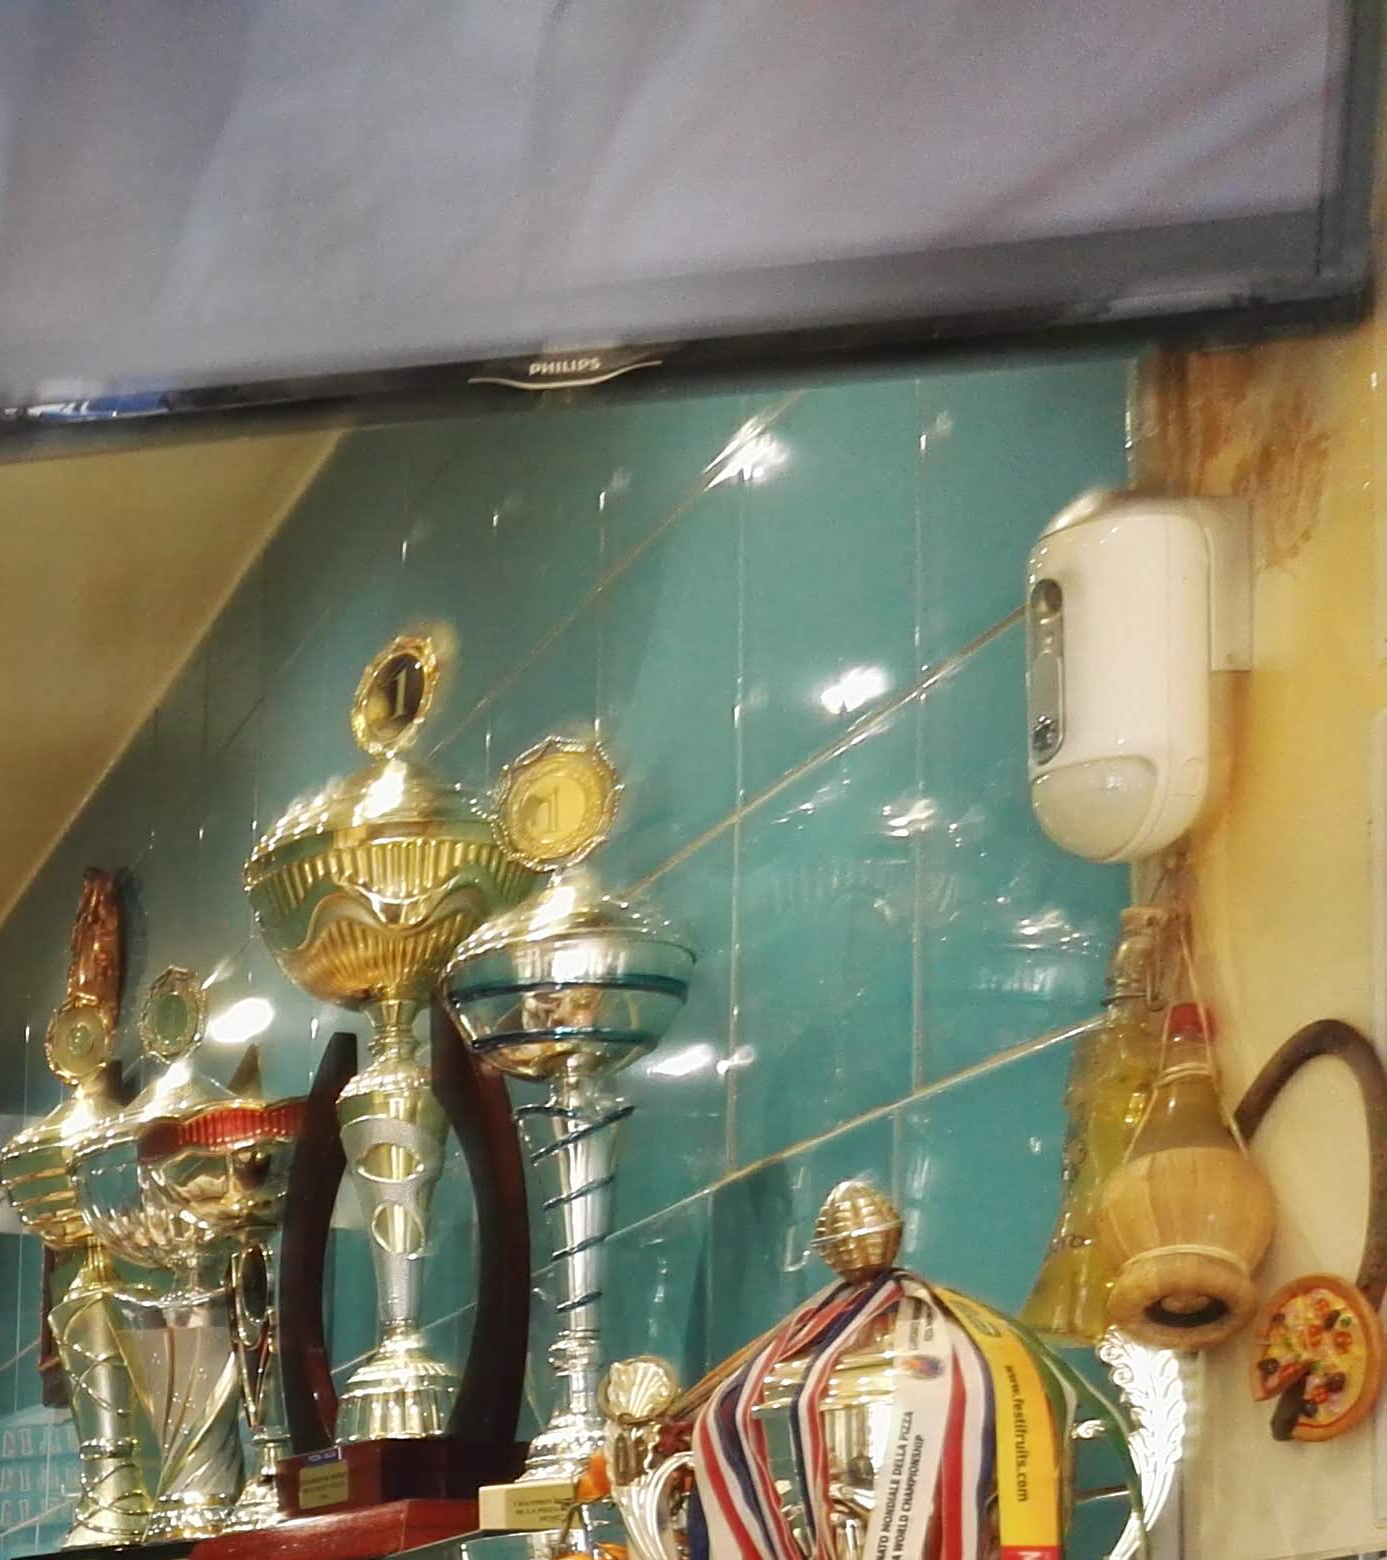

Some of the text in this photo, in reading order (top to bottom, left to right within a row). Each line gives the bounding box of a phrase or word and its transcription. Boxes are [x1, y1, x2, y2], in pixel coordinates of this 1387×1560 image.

[529, 357, 601, 376] PHILIPS
[881, 1484, 899, 1533] MONDIALE
[893, 1445, 907, 1477] DELLA
[900, 1411, 914, 1441] PIZZA
[1005, 1365, 1030, 1502] www.festifruits.com
[895, 1514, 909, 1552] WORLD
[903, 1435, 923, 1511] CHAMPIONSHIP
